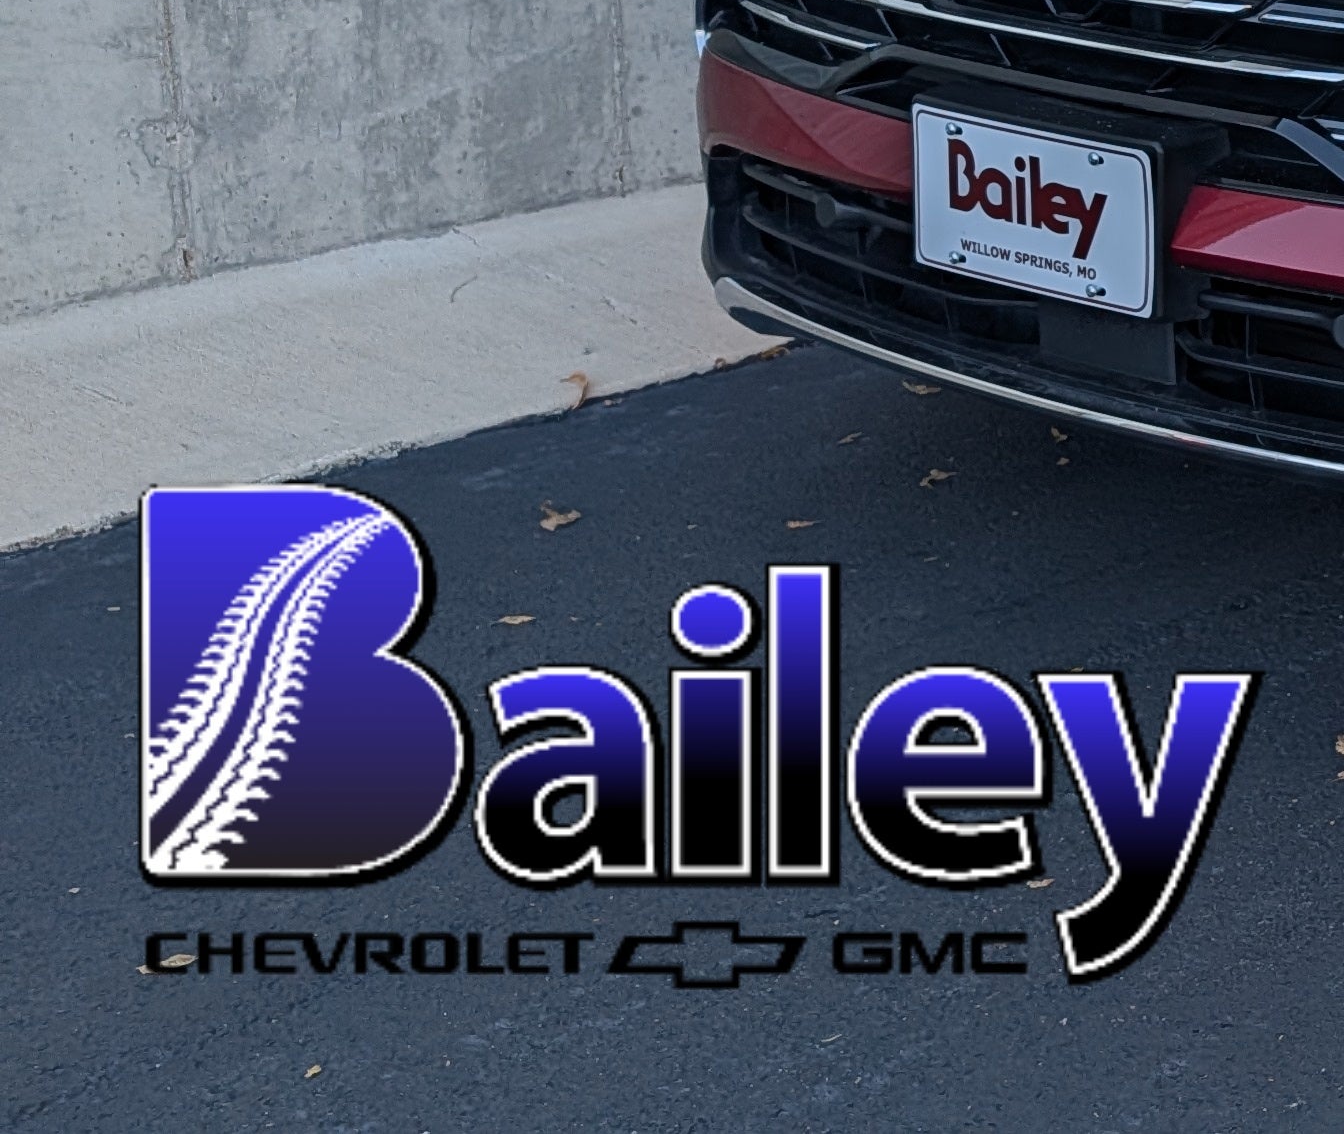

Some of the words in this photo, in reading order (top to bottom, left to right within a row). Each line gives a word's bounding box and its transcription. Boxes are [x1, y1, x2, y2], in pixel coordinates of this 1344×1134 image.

[947, 138, 1108, 260] Bailey
[960, 238, 1010, 261] WILLOW
[1014, 251, 1073, 277] SPRINGS,
[1076, 265, 1097, 280] MO
